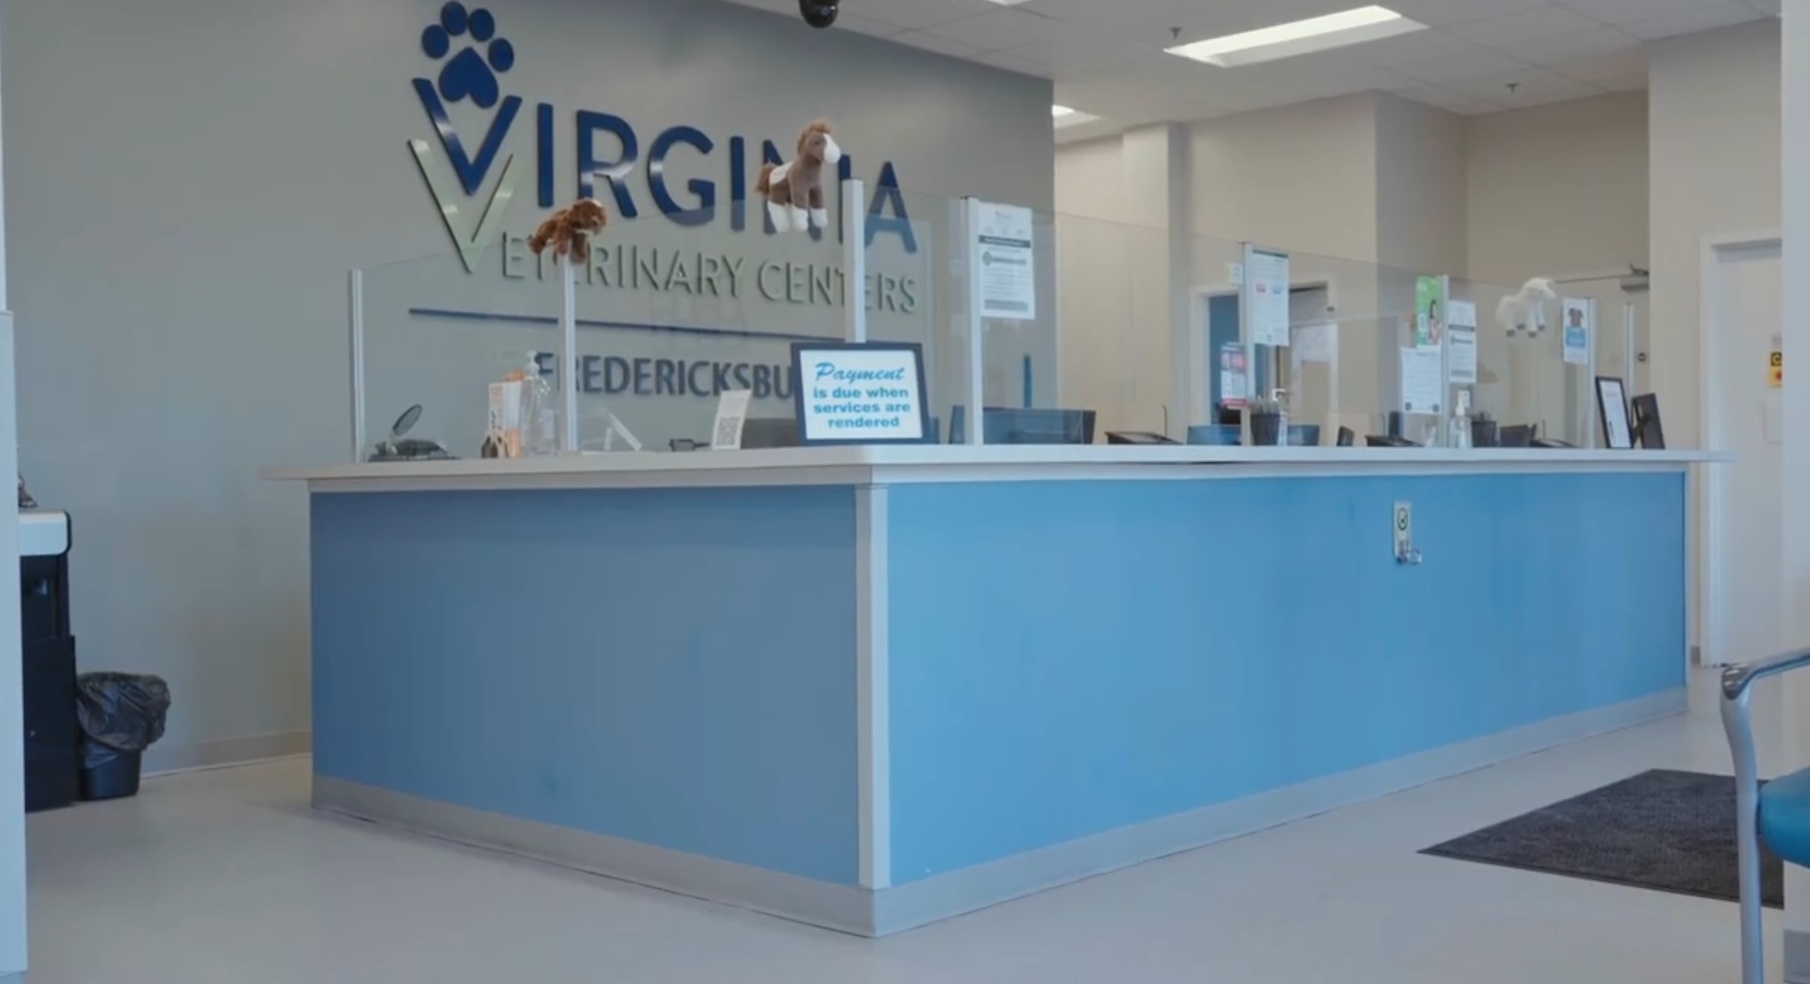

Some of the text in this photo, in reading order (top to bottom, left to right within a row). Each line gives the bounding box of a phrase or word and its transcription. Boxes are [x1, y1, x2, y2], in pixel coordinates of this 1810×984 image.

[815, 362, 905, 384] Payment
[813, 387, 909, 399] is due when
[813, 402, 911, 414] services are
[828, 416, 900, 429] rendered
